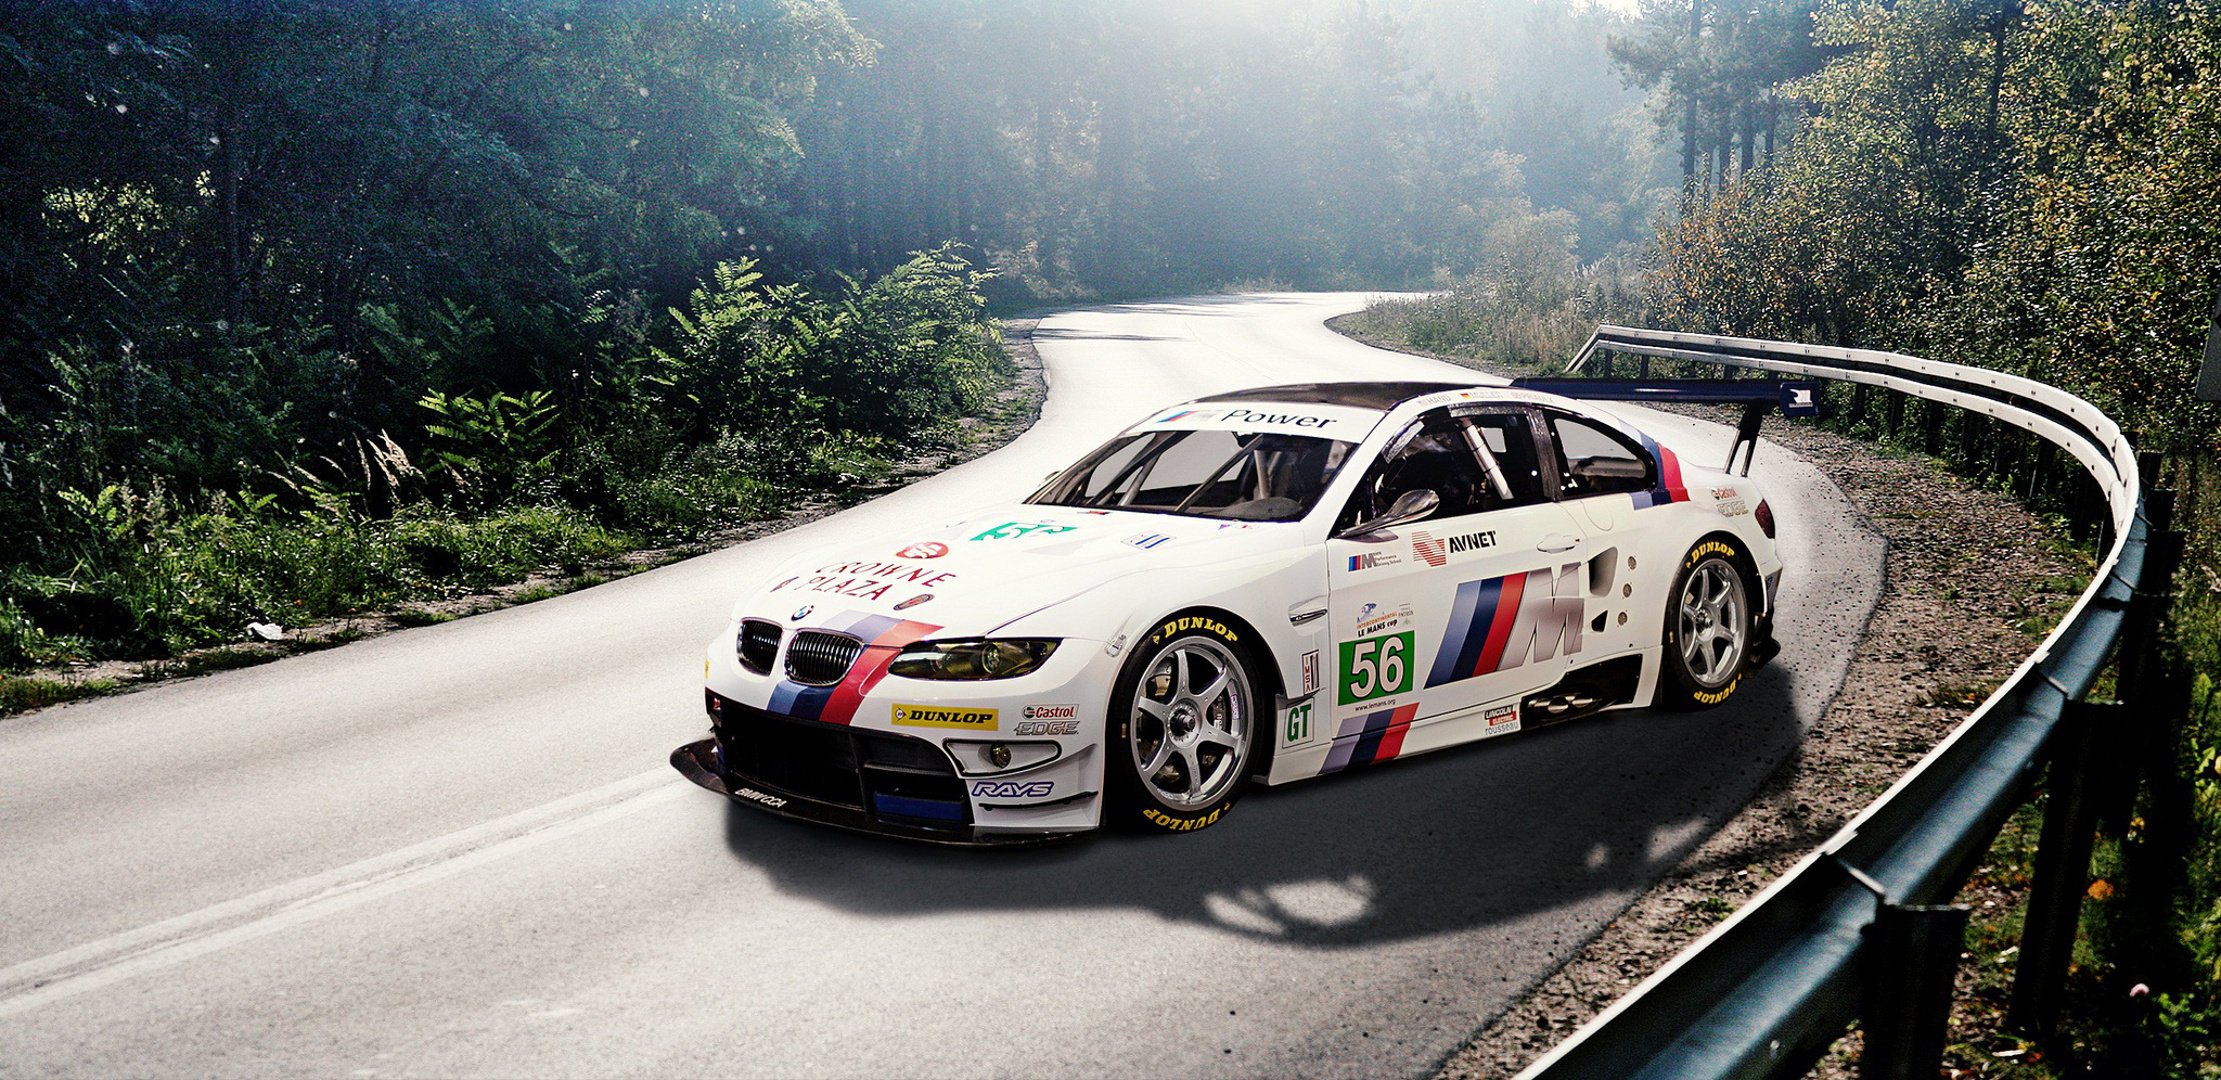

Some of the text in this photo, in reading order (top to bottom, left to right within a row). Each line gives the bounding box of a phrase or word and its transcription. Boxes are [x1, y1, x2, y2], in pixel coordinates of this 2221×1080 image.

[1221, 409, 1338, 428] Power
[1449, 530, 1497, 554] AVNET
[1692, 541, 1735, 564] DUNLOP
[815, 562, 957, 588] CROWNE
[794, 576, 893, 600] PLAZA
[1165, 616, 1239, 643] DUNLOP
[1358, 619, 1398, 638] LE MANS cup
[1349, 634, 1406, 700] 56
[1693, 680, 1736, 704] DUNLOP
[1035, 706, 1075, 719] Castrol
[1355, 699, 1396, 712] www.lemans.org
[1486, 706, 1513, 719] LINCOLN
[909, 709, 993, 724] DUNLOP
[1287, 703, 1312, 742] GT
[1014, 721, 1080, 736] EDGE
[735, 787, 762, 801] BMW
[972, 781, 1055, 797] RAYS
[1143, 807, 1221, 831] DUNLOP
